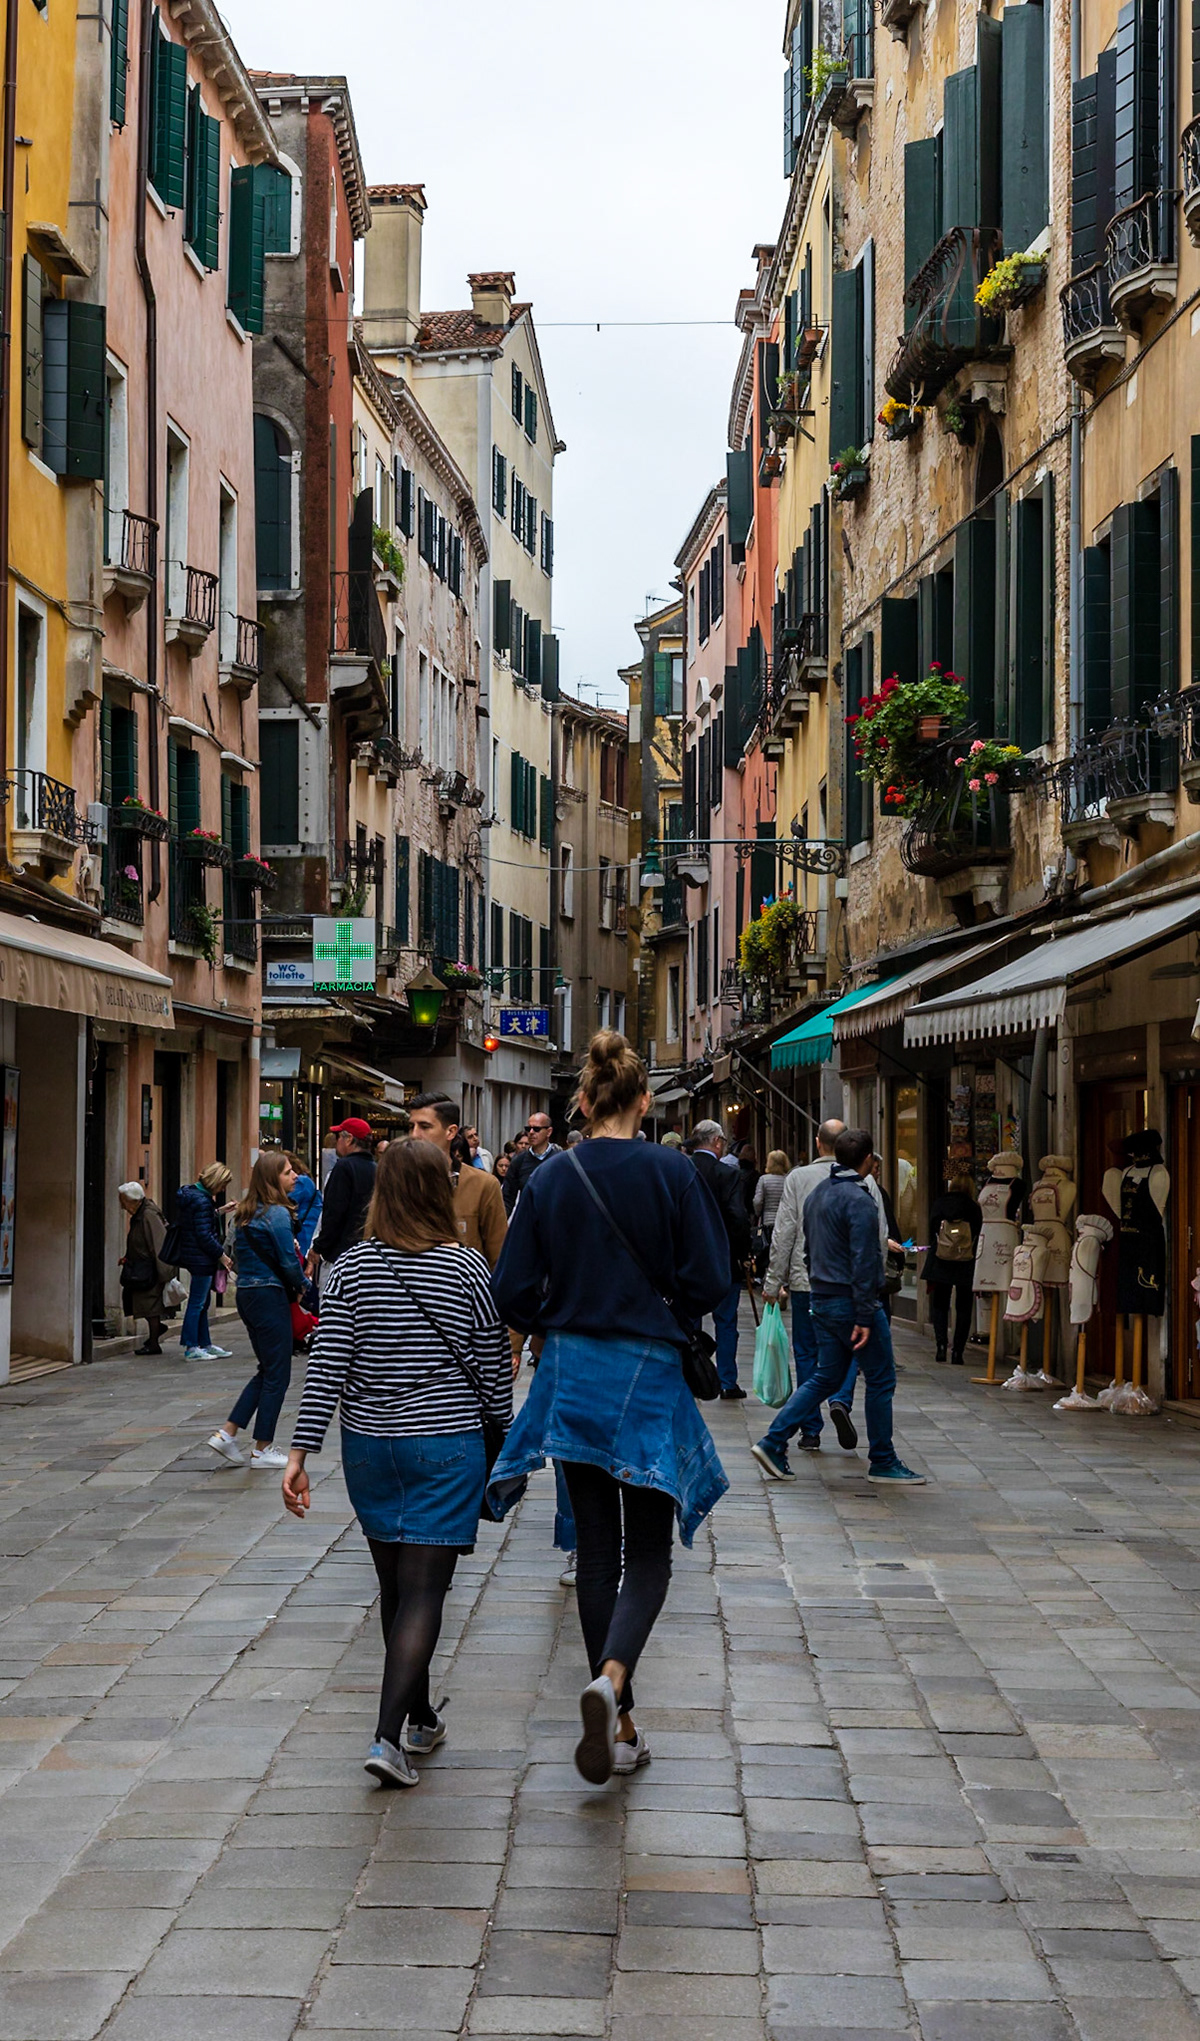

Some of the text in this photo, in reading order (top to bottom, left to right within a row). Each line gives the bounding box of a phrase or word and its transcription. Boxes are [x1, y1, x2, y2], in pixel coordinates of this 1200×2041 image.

[278, 964, 296, 972] WC
[269, 971, 305, 979] toilette
[314, 982, 374, 991] FARMACIA
[507, 1015, 541, 1035] 天津
